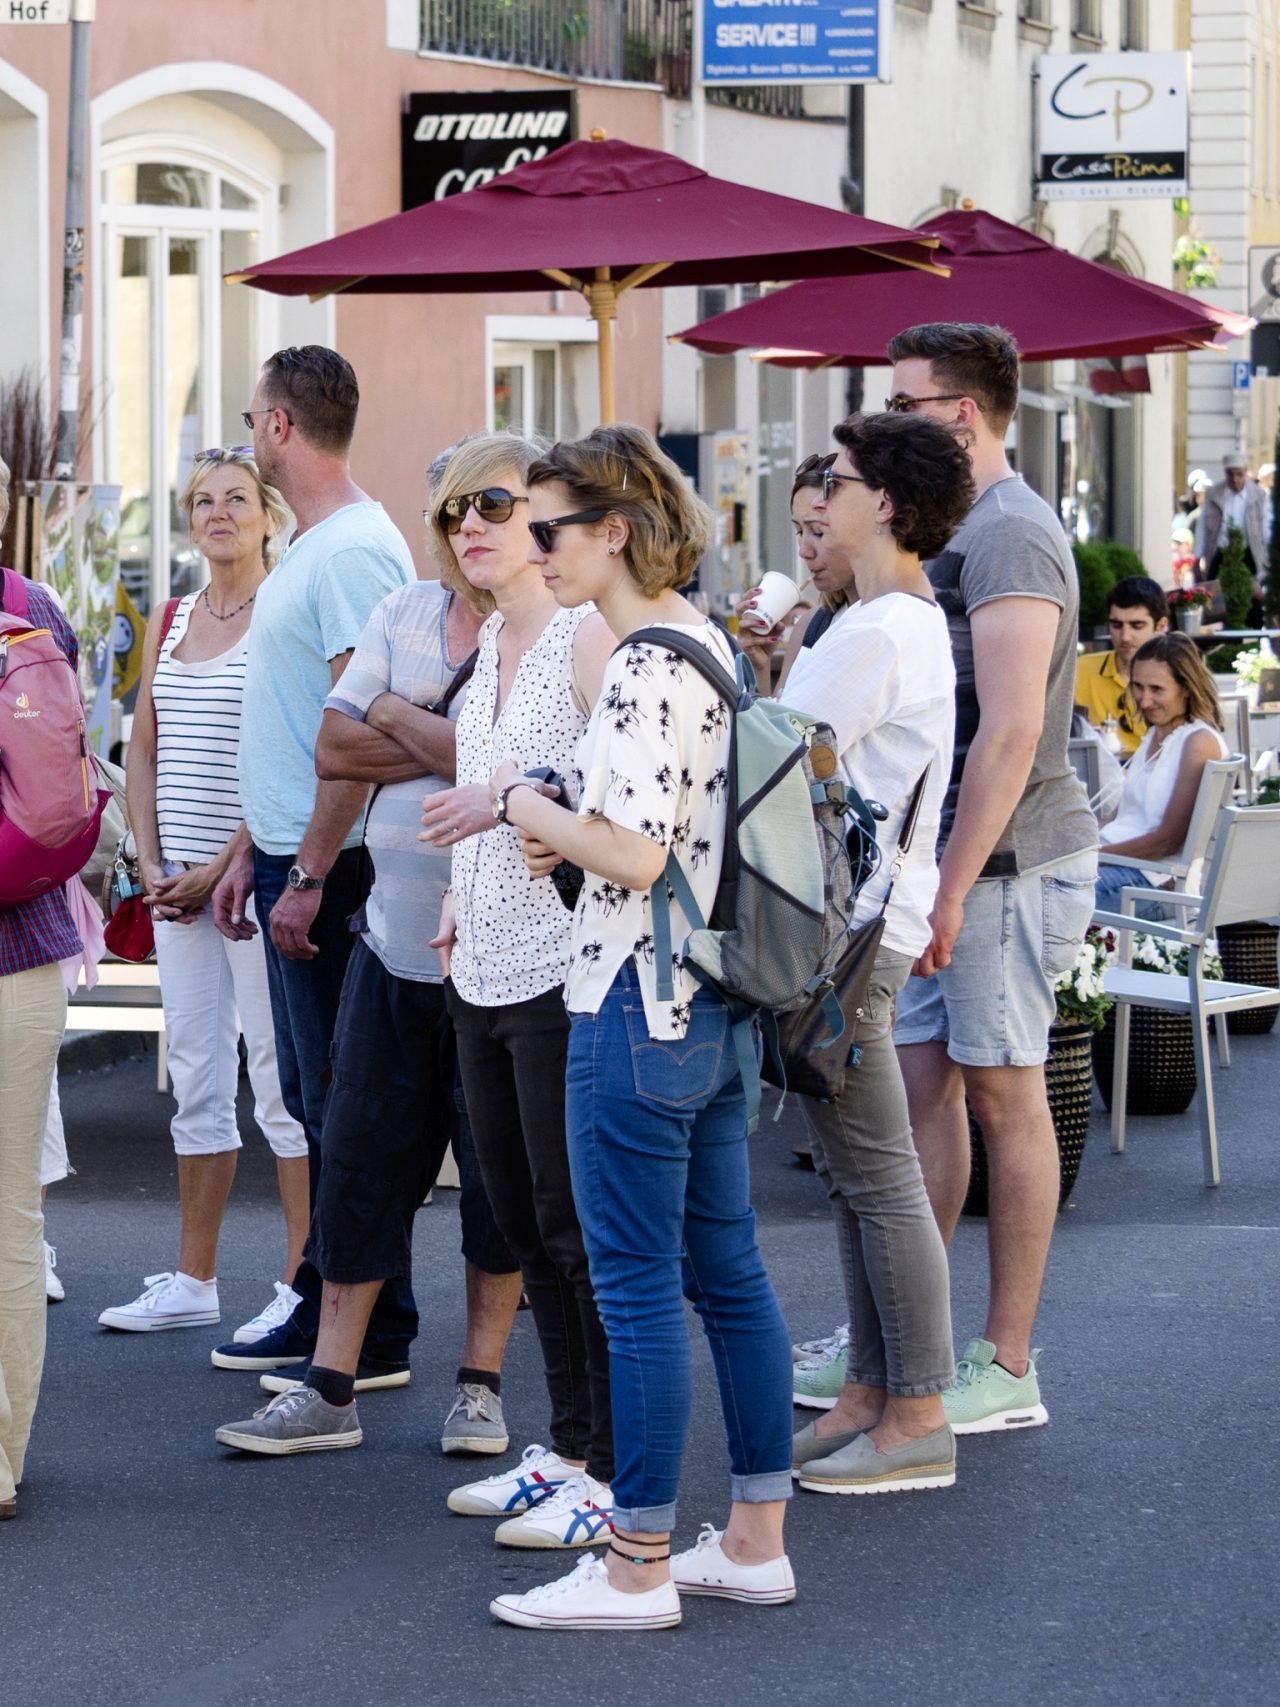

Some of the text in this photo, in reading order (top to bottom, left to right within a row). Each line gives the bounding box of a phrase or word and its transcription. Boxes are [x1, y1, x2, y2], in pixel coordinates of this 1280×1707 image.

[10, 1, 49, 20] Hof
[716, 23, 799, 47] SERVICE
[413, 111, 568, 141] OTTOLINA
[1236, 364, 1247, 387] P
[14, 710, 40, 719] deuter
